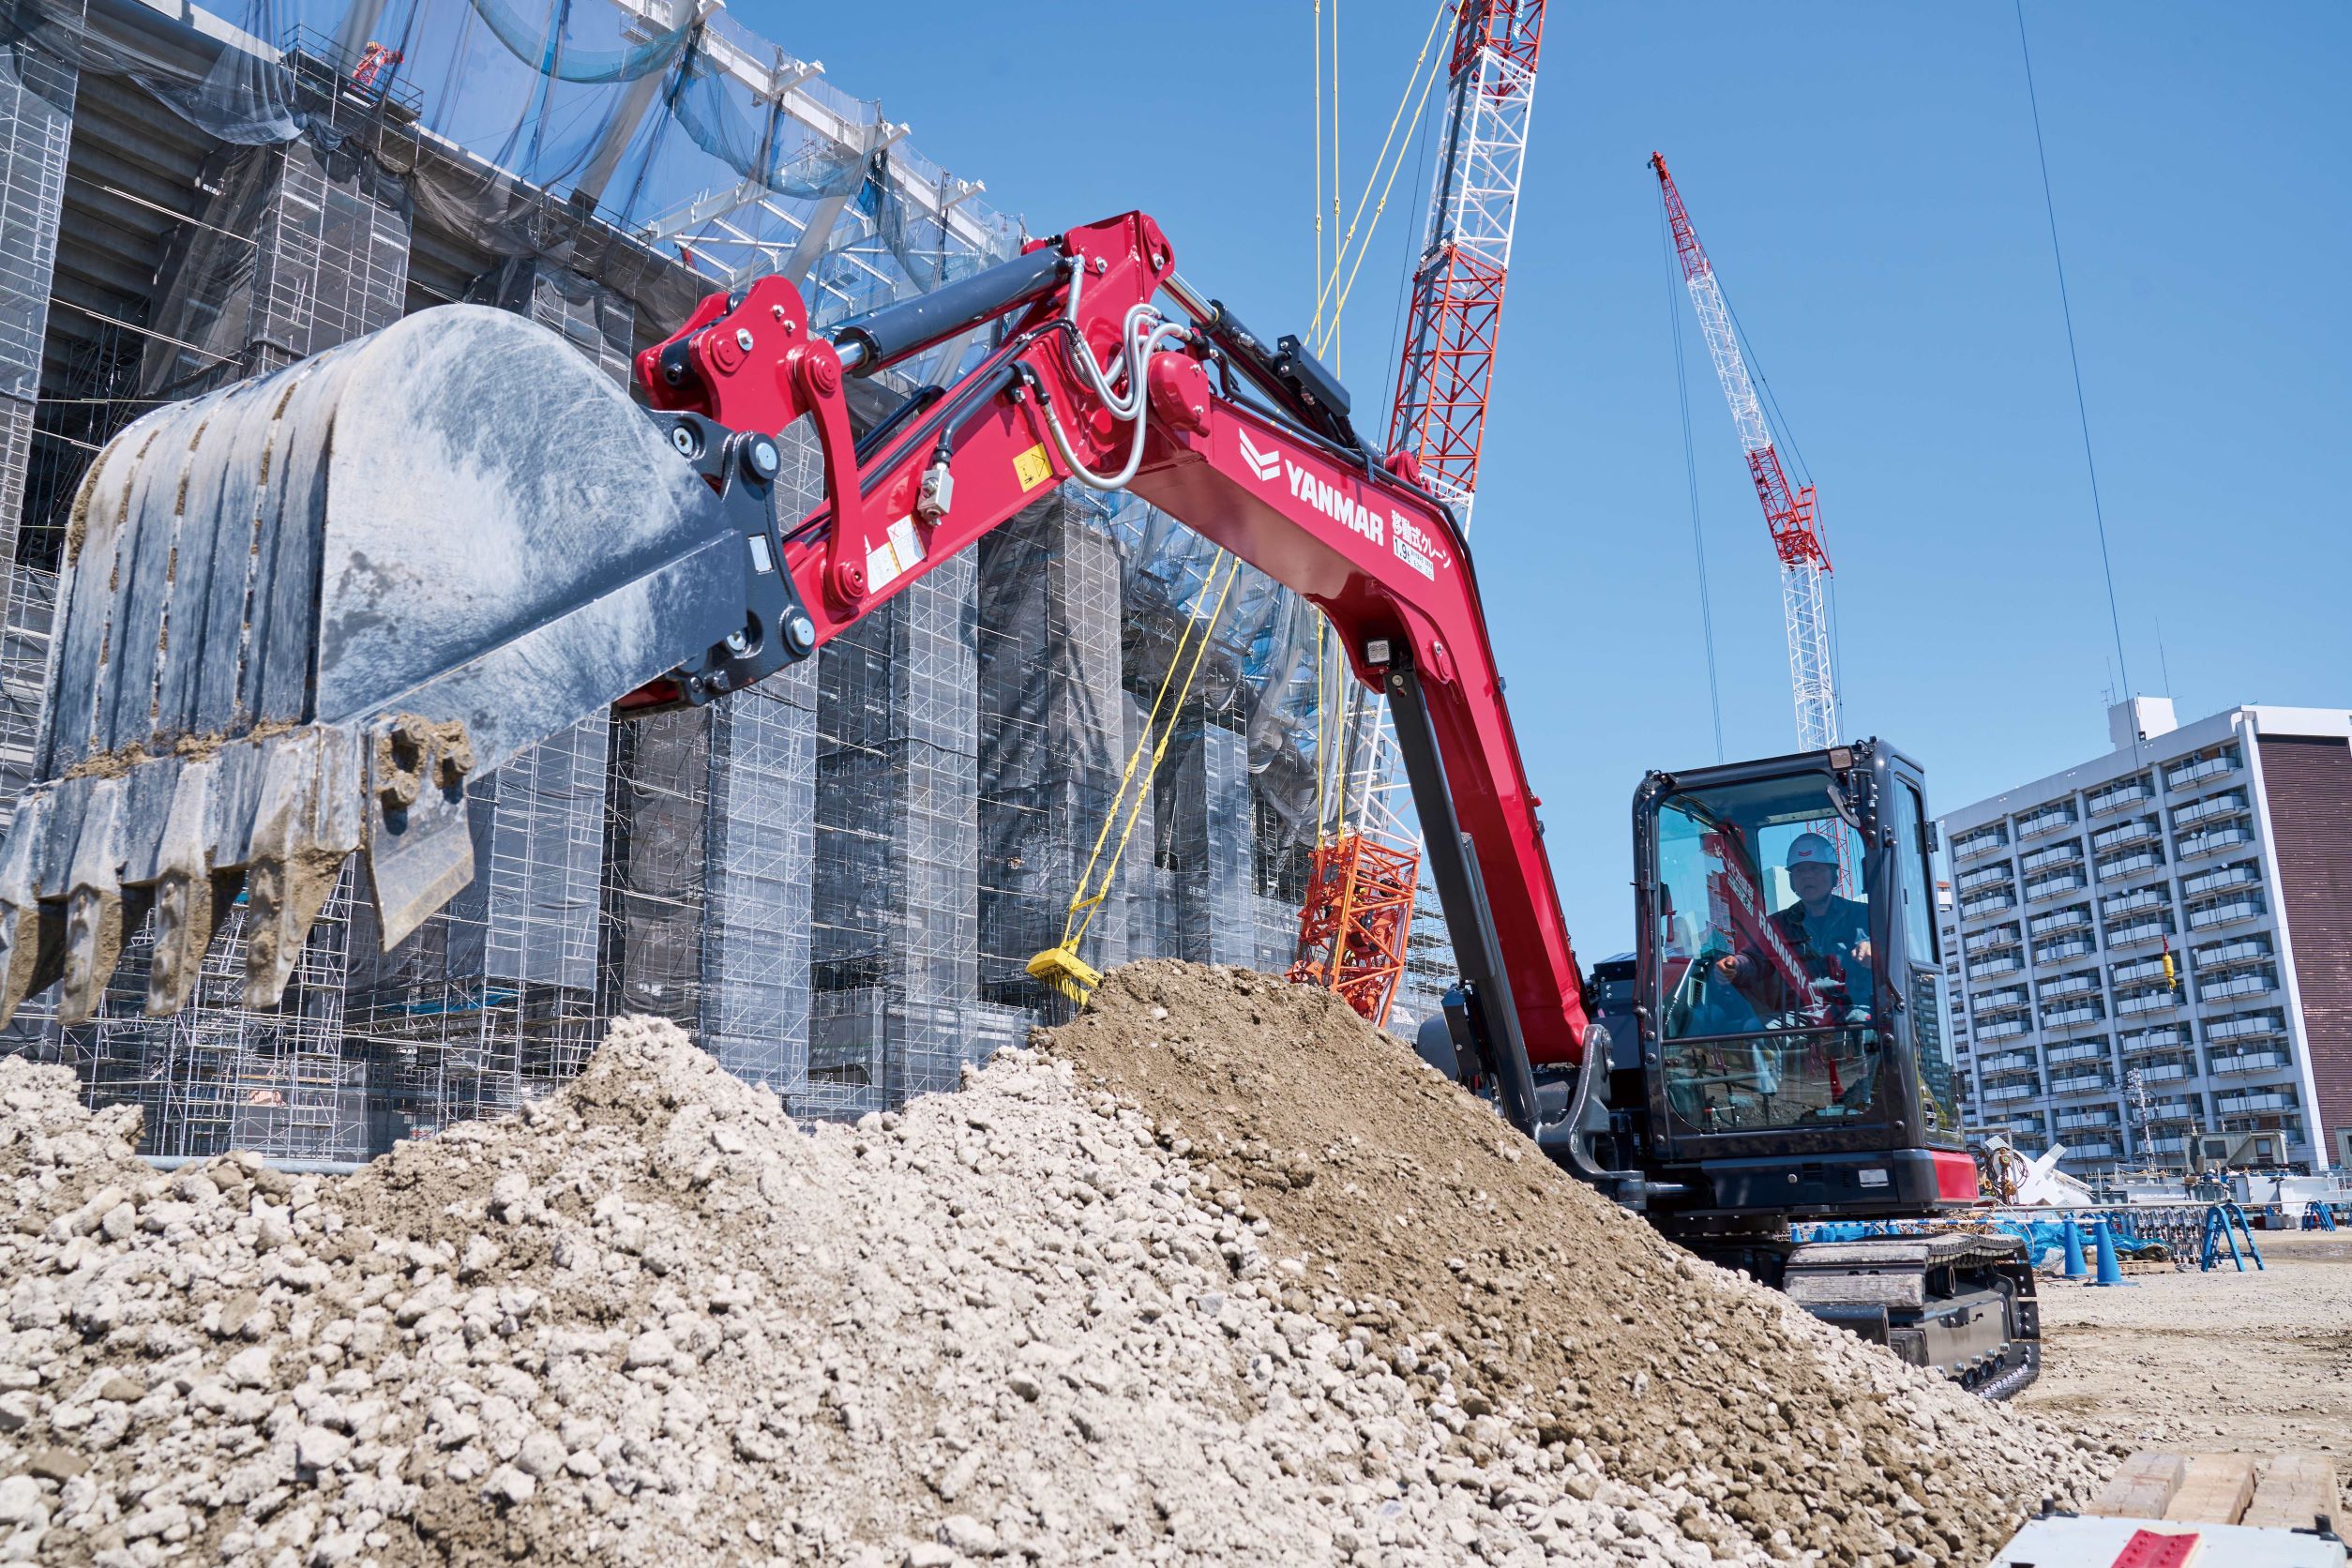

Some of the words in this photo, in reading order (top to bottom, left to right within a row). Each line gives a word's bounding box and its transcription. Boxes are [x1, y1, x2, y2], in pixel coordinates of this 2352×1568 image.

[1285, 459, 1383, 547] YANMAR
[1391, 509, 1451, 568] 移動式クレーン
